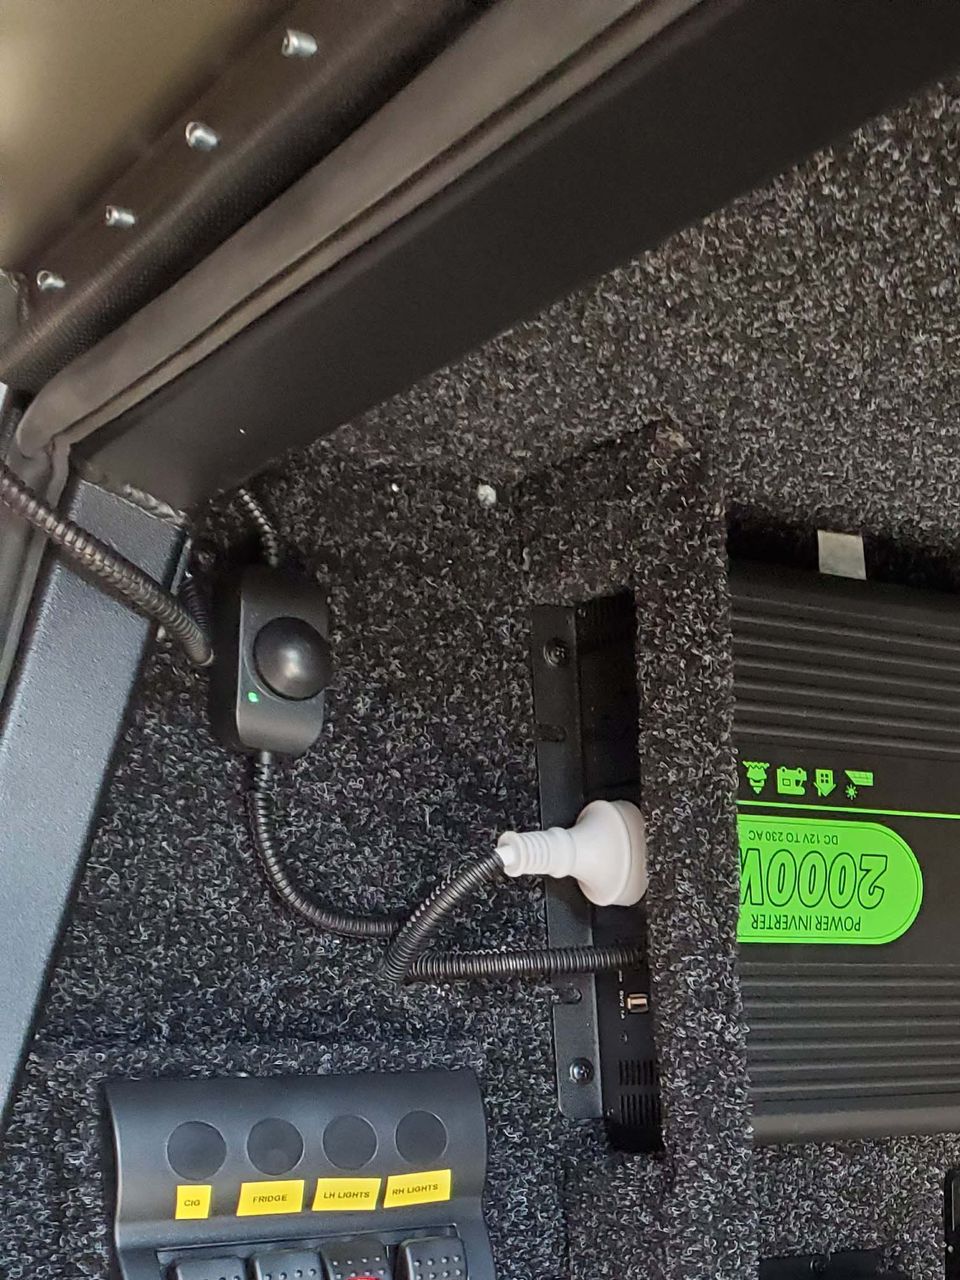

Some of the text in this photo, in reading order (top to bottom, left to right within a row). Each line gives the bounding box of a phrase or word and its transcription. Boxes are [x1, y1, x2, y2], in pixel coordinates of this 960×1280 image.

[748, 830, 839, 846] DC 12V TO 230 AC
[751, 913, 862, 932] POWER INVERTER
[323, 1190, 371, 1200] LH LIGHTS
[391, 1183, 439, 1197] RH LIGHTS
[183, 1198, 201, 1208] CIG
[252, 1193, 288, 1205] FRIDGE
